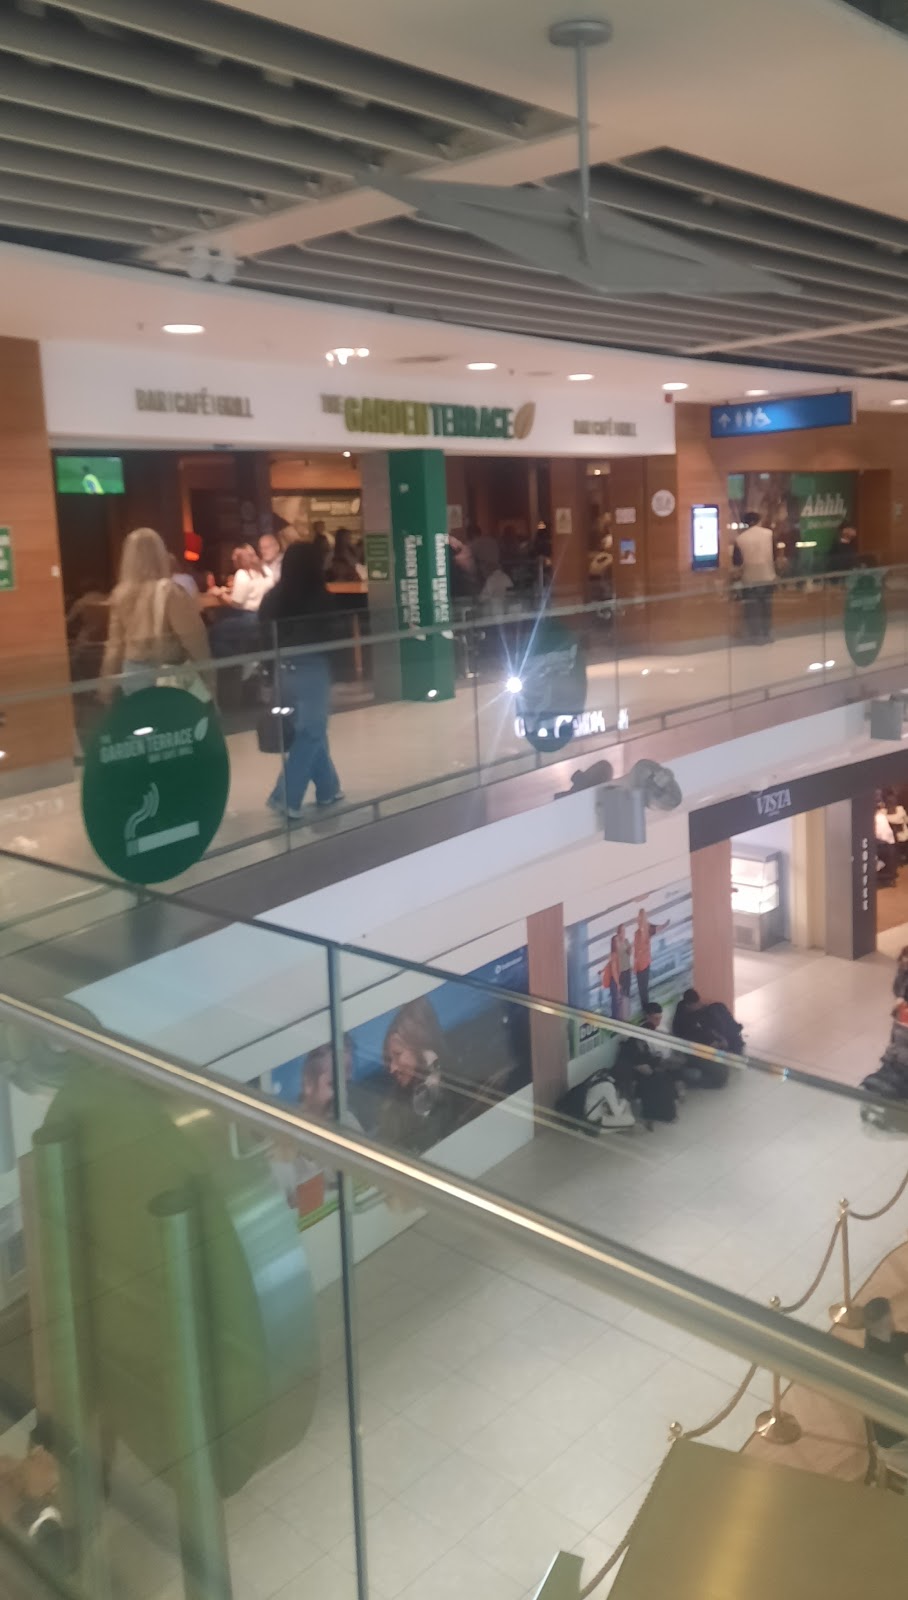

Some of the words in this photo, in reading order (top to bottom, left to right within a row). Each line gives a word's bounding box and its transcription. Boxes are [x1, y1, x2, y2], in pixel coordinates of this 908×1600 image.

[343, 397, 430, 436] GARDEN
[430, 403, 515, 440] TERRACE
[100, 739, 145, 764] GARDEN
[146, 728, 194, 753] TERRACE
[756, 788, 792, 815] VISTA
[861, 837, 869, 911] COFFEE
